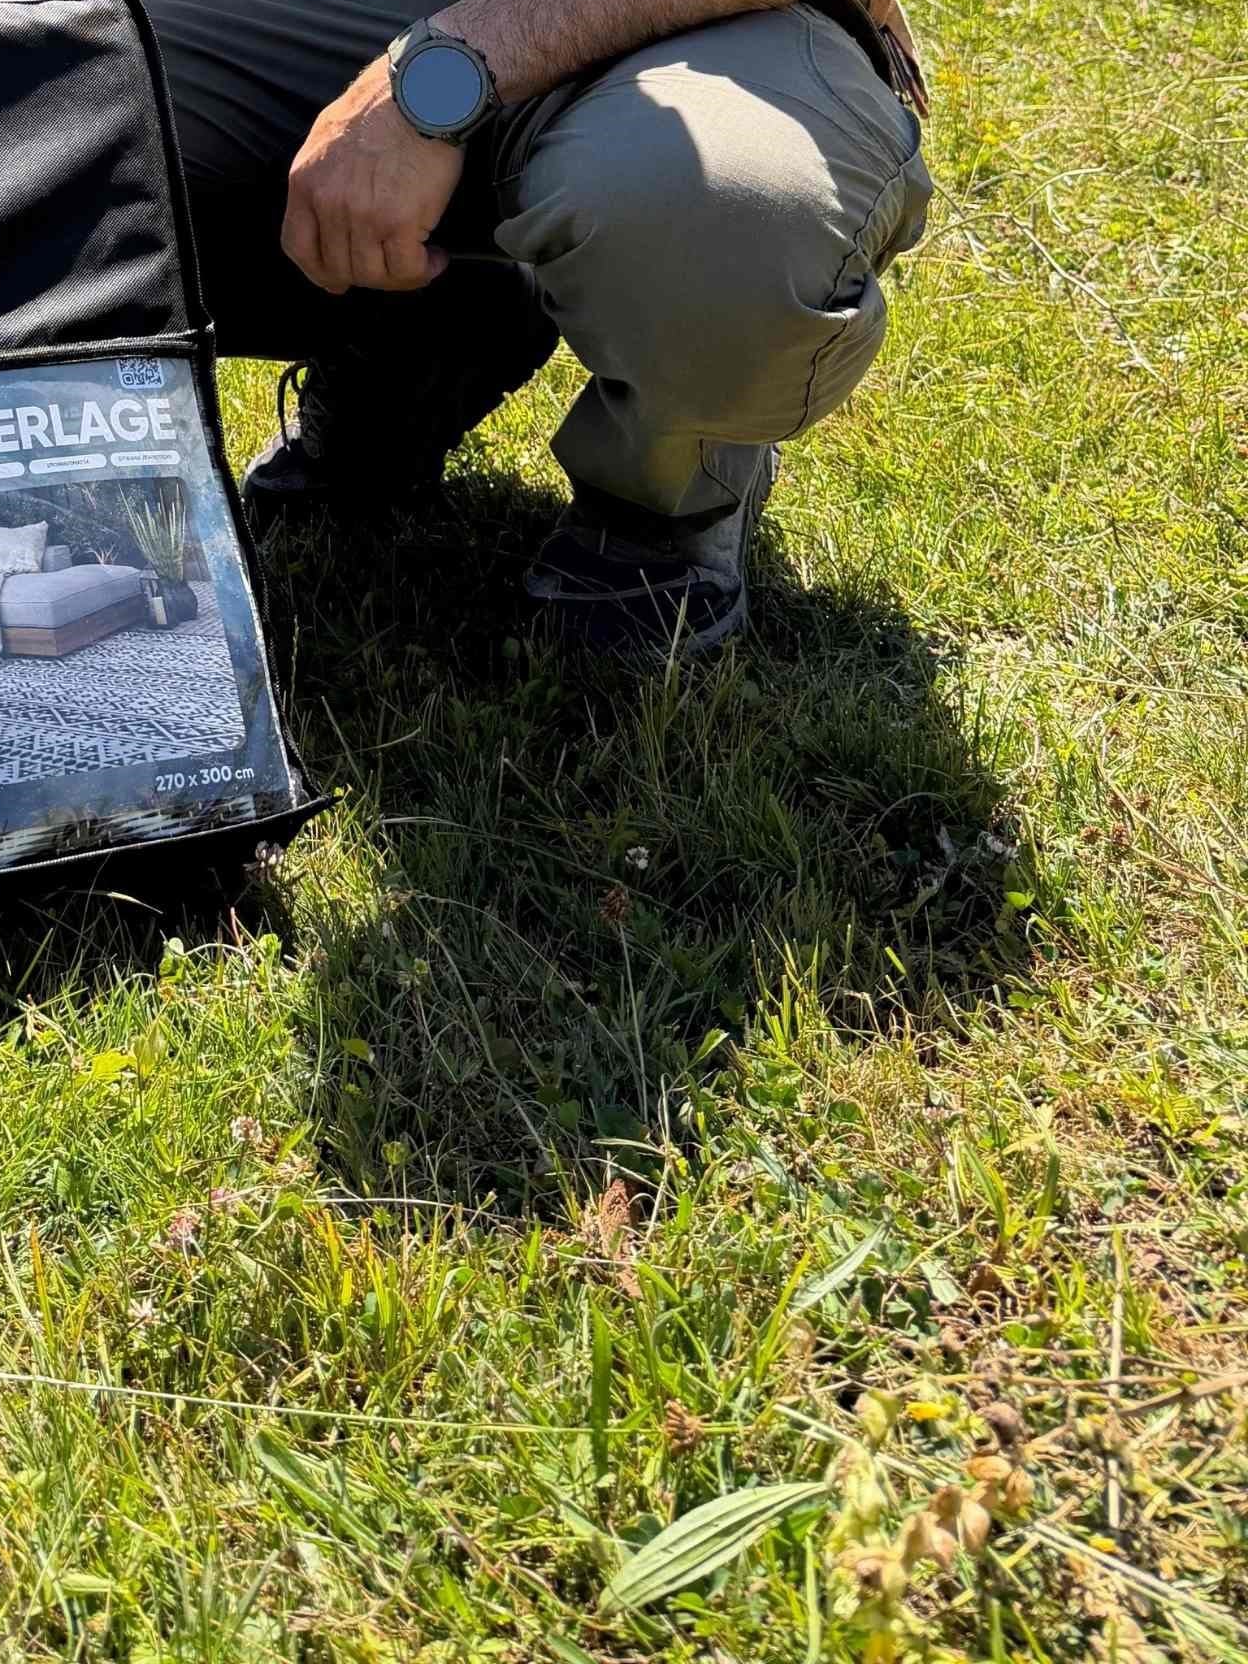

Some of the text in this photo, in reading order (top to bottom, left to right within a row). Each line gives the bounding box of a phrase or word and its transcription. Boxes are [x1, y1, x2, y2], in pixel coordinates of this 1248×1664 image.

[156, 766, 255, 791] 270 x 300 cm
